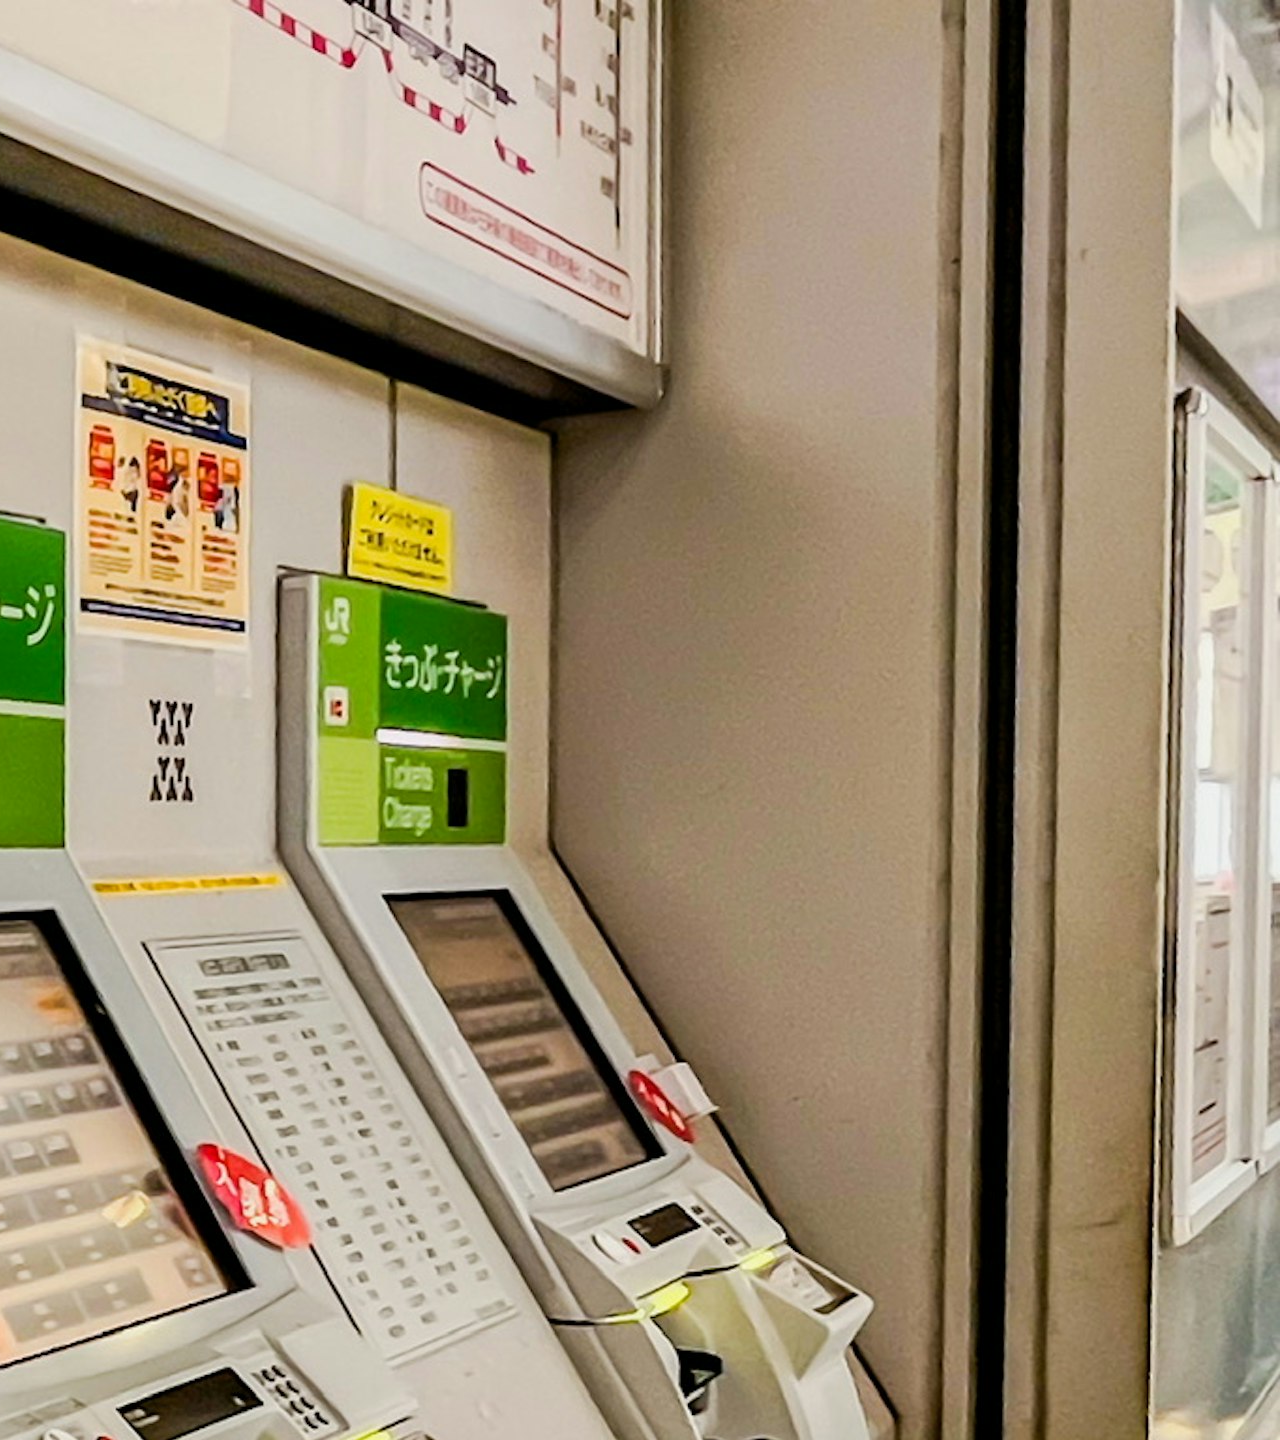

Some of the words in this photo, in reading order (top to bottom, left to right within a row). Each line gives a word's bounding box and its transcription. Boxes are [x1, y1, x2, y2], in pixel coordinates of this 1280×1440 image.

[325, 597, 351, 634] JR
[384, 757, 434, 791] Tickets
[383, 796, 434, 836] Charge
